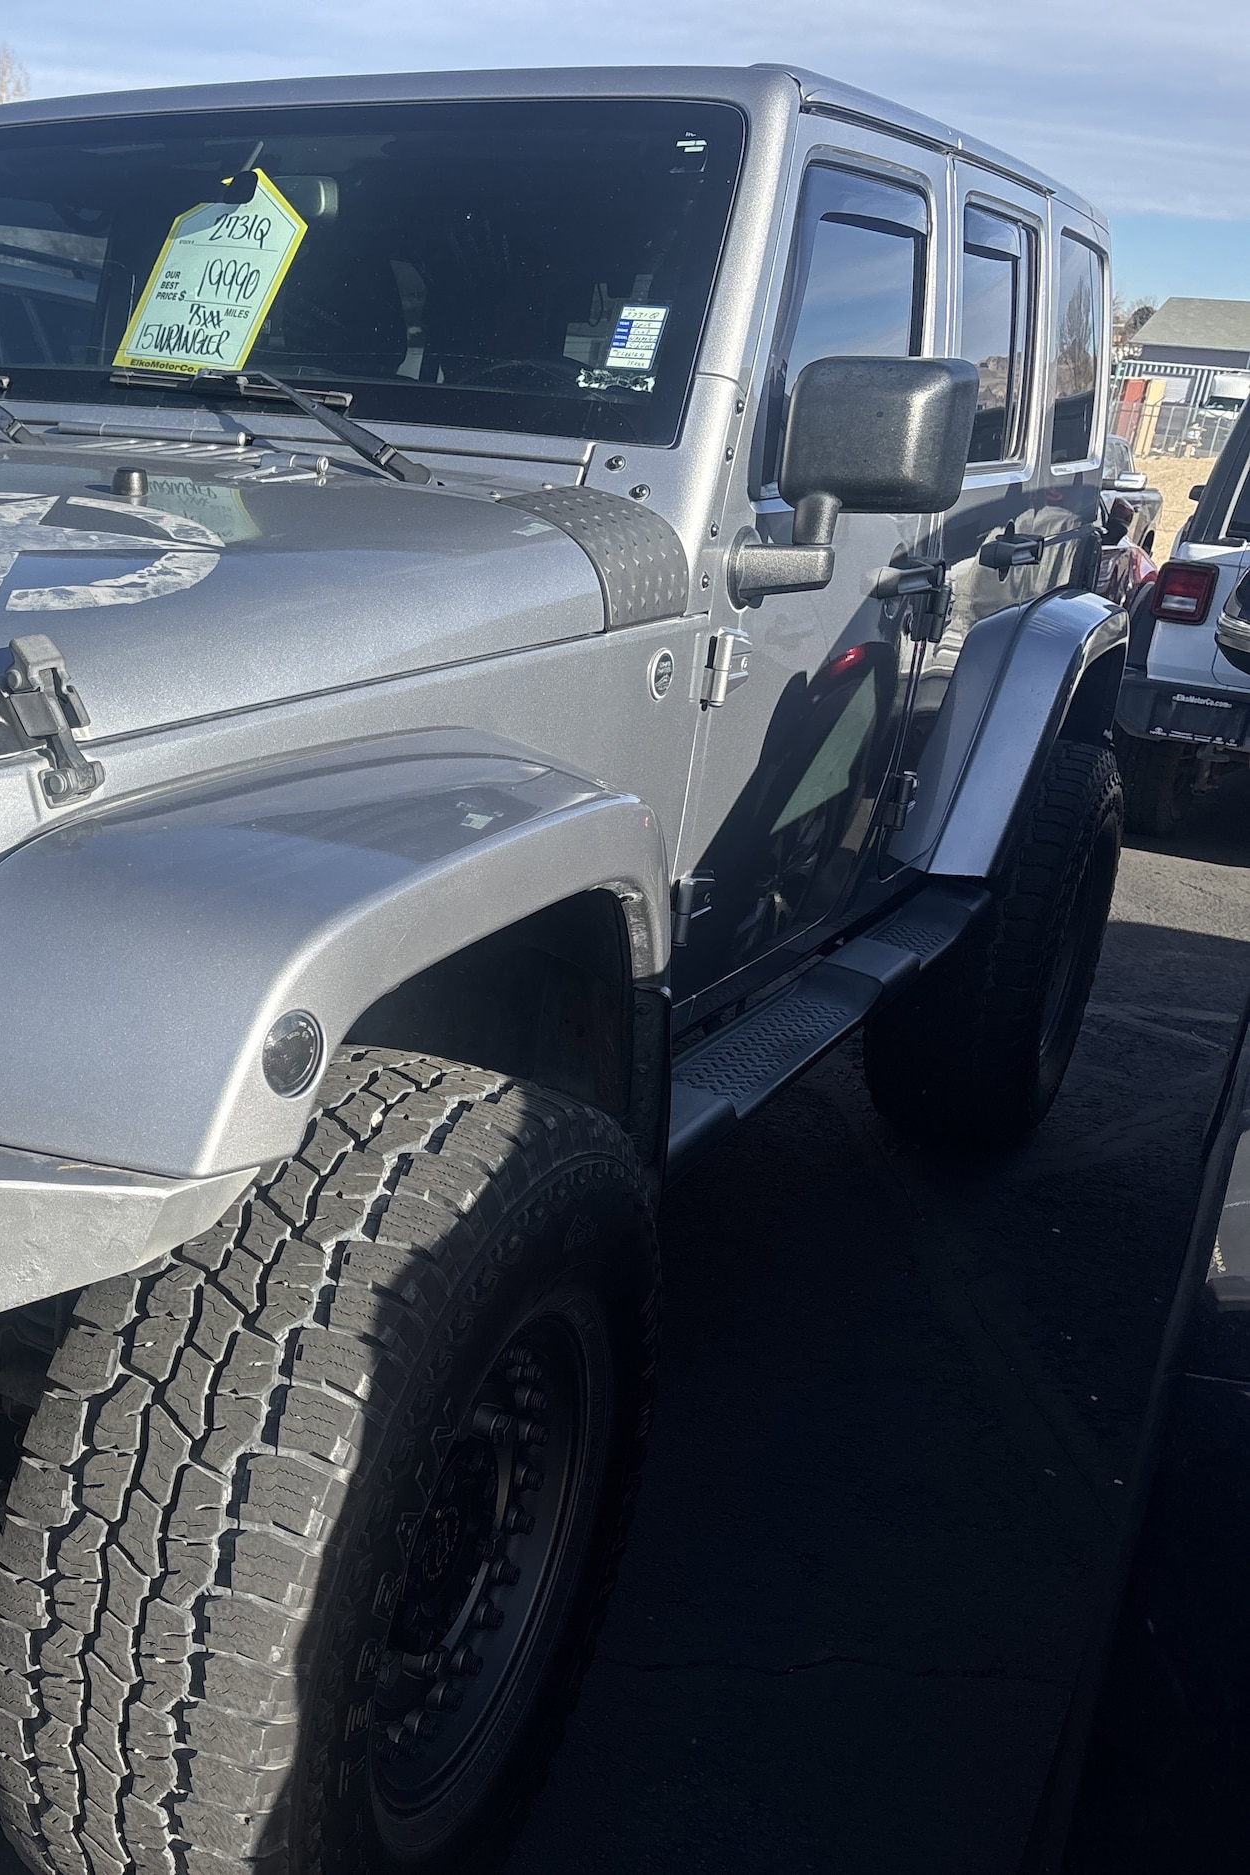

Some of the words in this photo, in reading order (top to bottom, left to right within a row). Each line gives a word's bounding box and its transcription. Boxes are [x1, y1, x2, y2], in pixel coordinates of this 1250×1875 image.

[209, 214, 271, 249] 2731Q
[164, 270, 181, 280] OUR
[197, 259, 260, 303] 19990
[160, 281, 180, 290] BEST
[155, 291, 178, 301] PRICE
[223, 307, 250, 320] MILES
[130, 359, 197, 373] ElkoMotorCo.
